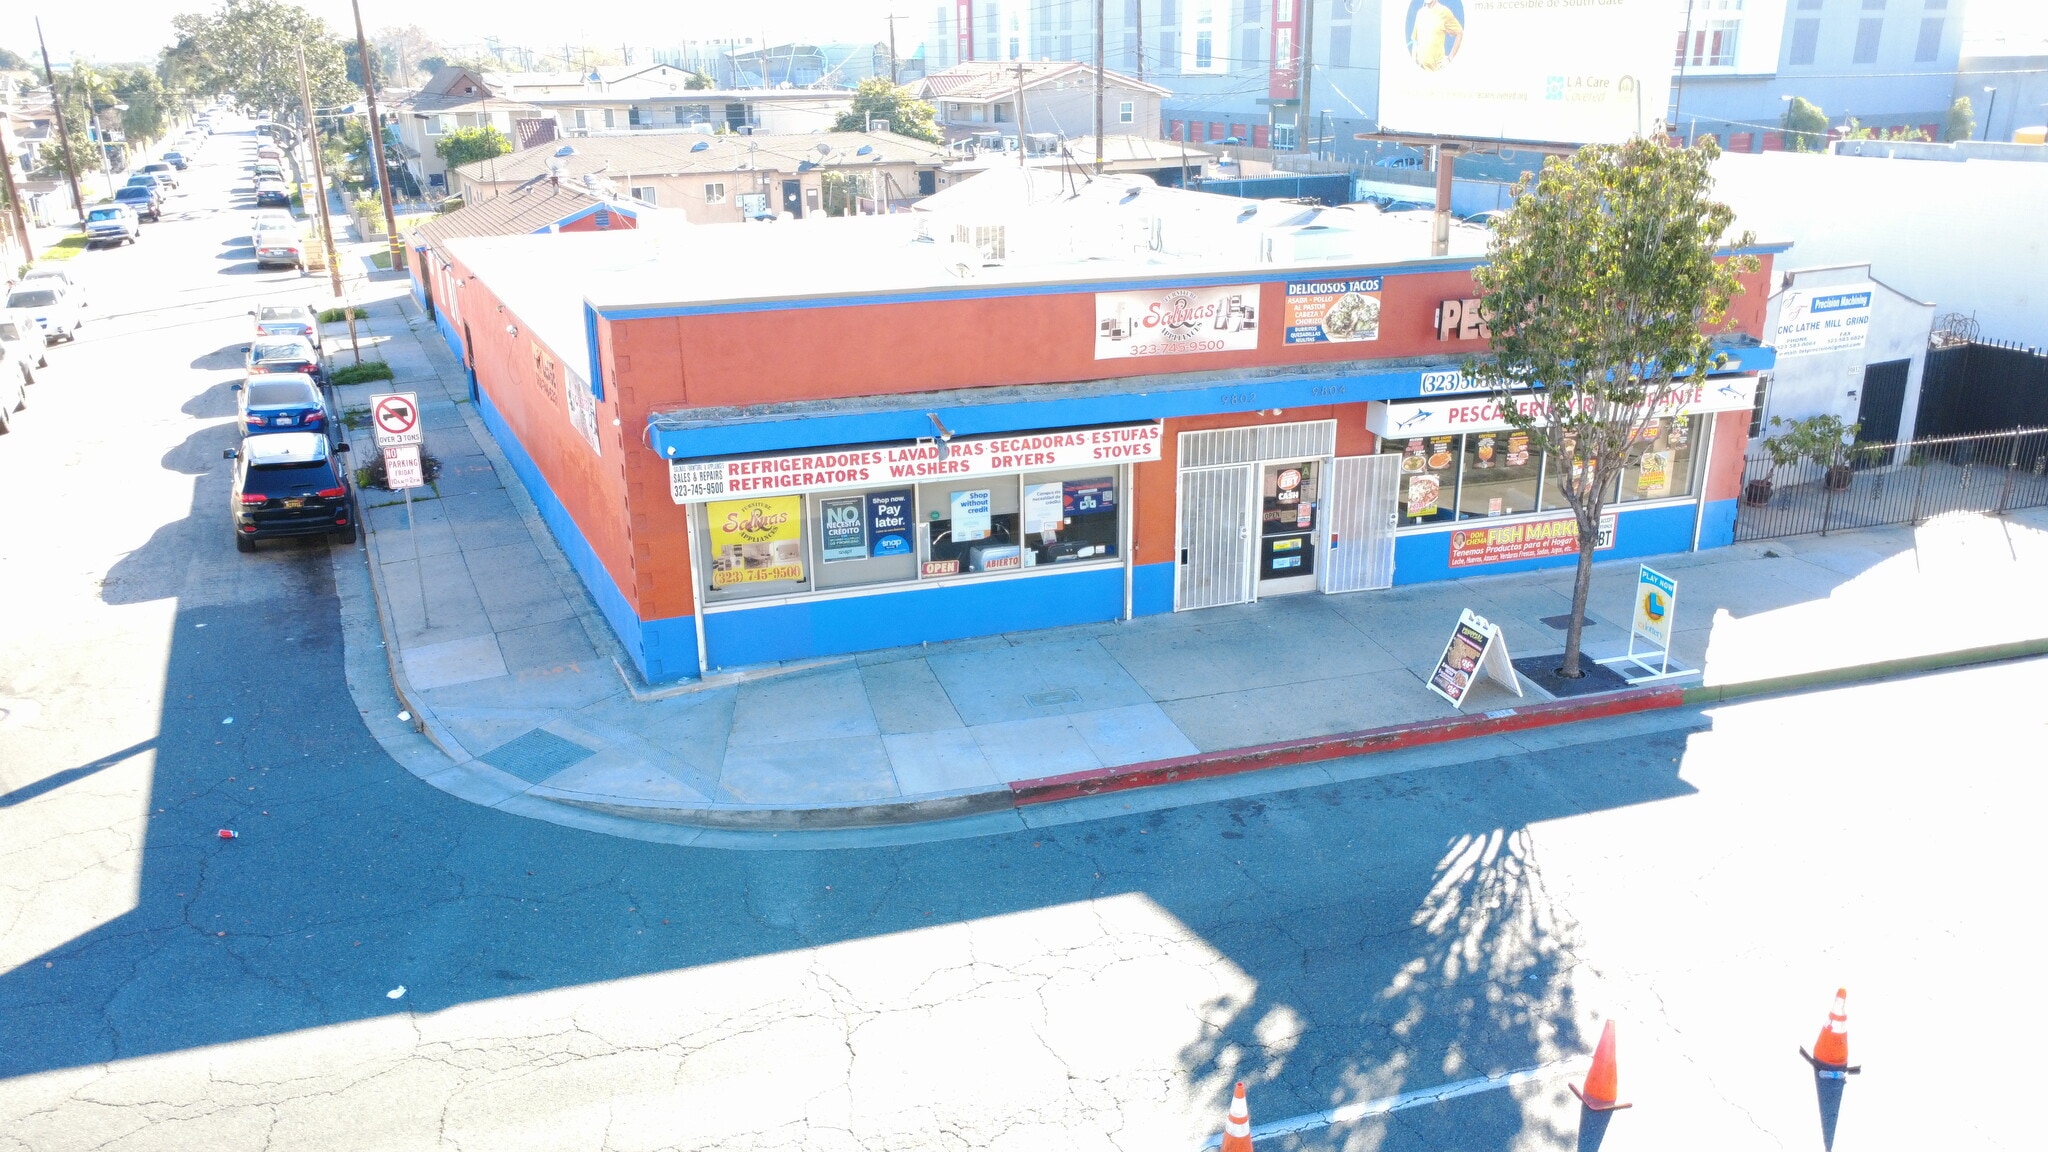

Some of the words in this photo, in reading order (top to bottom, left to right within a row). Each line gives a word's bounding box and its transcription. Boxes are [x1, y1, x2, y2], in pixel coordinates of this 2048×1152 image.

[1497, 0, 1543, 9] accesible
[1587, 76, 1610, 88] Care
[1289, 283, 1346, 295] DELICIOSOS
[1349, 280, 1379, 292] TACOS
[1815, 299, 1840, 310] Precision
[1142, 302, 1215, 328] Salinas
[1777, 325, 1794, 335] CNC
[1796, 321, 1820, 333] LATHE
[1825, 318, 1842, 328] MILL
[1846, 315, 1869, 326] GRIND
[1130, 340, 1225, 355] 323-745-9500
[1313, 385, 1346, 397] 9804
[1222, 393, 1257, 406] 9802
[380, 436, 396, 444] OVER
[397, 434, 402, 443] 3
[386, 448, 397, 459] NO
[728, 451, 882, 476] REFRIGERADORES
[889, 442, 984, 463] LAVADRAS
[990, 434, 1085, 454] SECADORAS
[1092, 427, 1159, 445] ESTUFAS
[389, 459, 418, 469] PARKING
[729, 468, 870, 492] REFRIGERATORS
[890, 460, 971, 478] WASHERS
[991, 451, 1056, 469] DRYERS
[1093, 443, 1152, 460] STOVES
[674, 472, 691, 483] SALES
[693, 472, 698, 482] &
[700, 470, 723, 482] REPAIRS
[1302, 466, 1310, 476] A
[674, 482, 724, 498] 323-745-9500
[969, 492, 989, 500] Shop
[1278, 491, 1299, 501] CASH
[872, 497, 889, 505] Shop
[960, 499, 989, 508] without
[827, 506, 859, 524] NO
[878, 505, 901, 516] Pay
[967, 506, 989, 514] credit
[1265, 511, 1280, 521] OPEN
[722, 512, 788, 533] Salinas
[826, 520, 860, 529] NECESITA
[875, 517, 905, 528] later.
[739, 526, 779, 542] APPLIANCES
[1487, 526, 1523, 546] FISH
[1526, 519, 1580, 542] MARKE
[1453, 548, 1484, 557] Tenemos
[1485, 543, 1522, 554] Productos
[1523, 541, 1541, 552] para
[1543, 540, 1550, 548] el
[1551, 537, 1573, 548] Hogar
[1466, 537, 1487, 546] CHEMA
[986, 556, 1019, 569] ABIERTO
[1452, 557, 1466, 566] Leche,
[1500, 551, 1518, 560] Verduras
[926, 561, 955, 574] OPEN
[714, 569, 744, 585] (323)
[747, 564, 801, 581] 745-9500
[1643, 571, 1658, 584] PLAY
[1660, 580, 1673, 592] NOW
